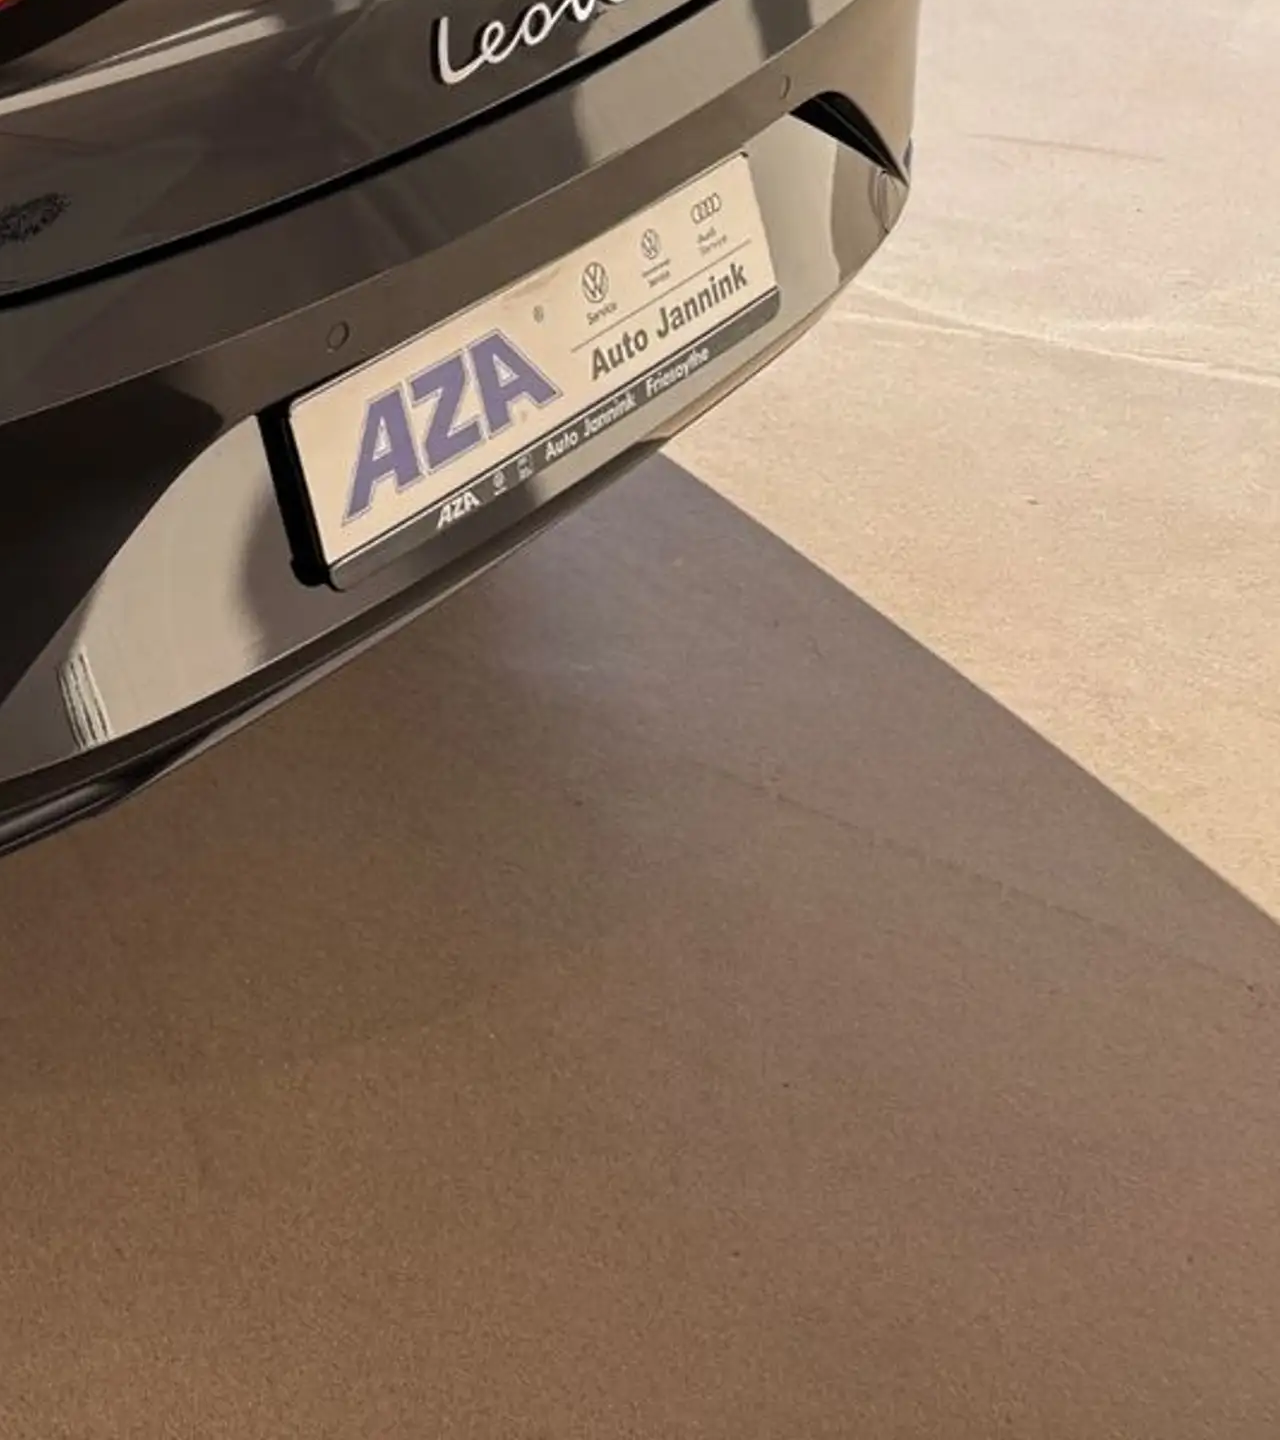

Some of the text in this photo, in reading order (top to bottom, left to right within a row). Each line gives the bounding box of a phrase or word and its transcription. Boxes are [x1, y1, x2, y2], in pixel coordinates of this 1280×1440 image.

[592, 263, 747, 380] Auto Jannink
[342, 328, 563, 527] AZA
[436, 491, 481, 530] AZA
[544, 430, 579, 462] Auto
[584, 392, 637, 438] Jannink
